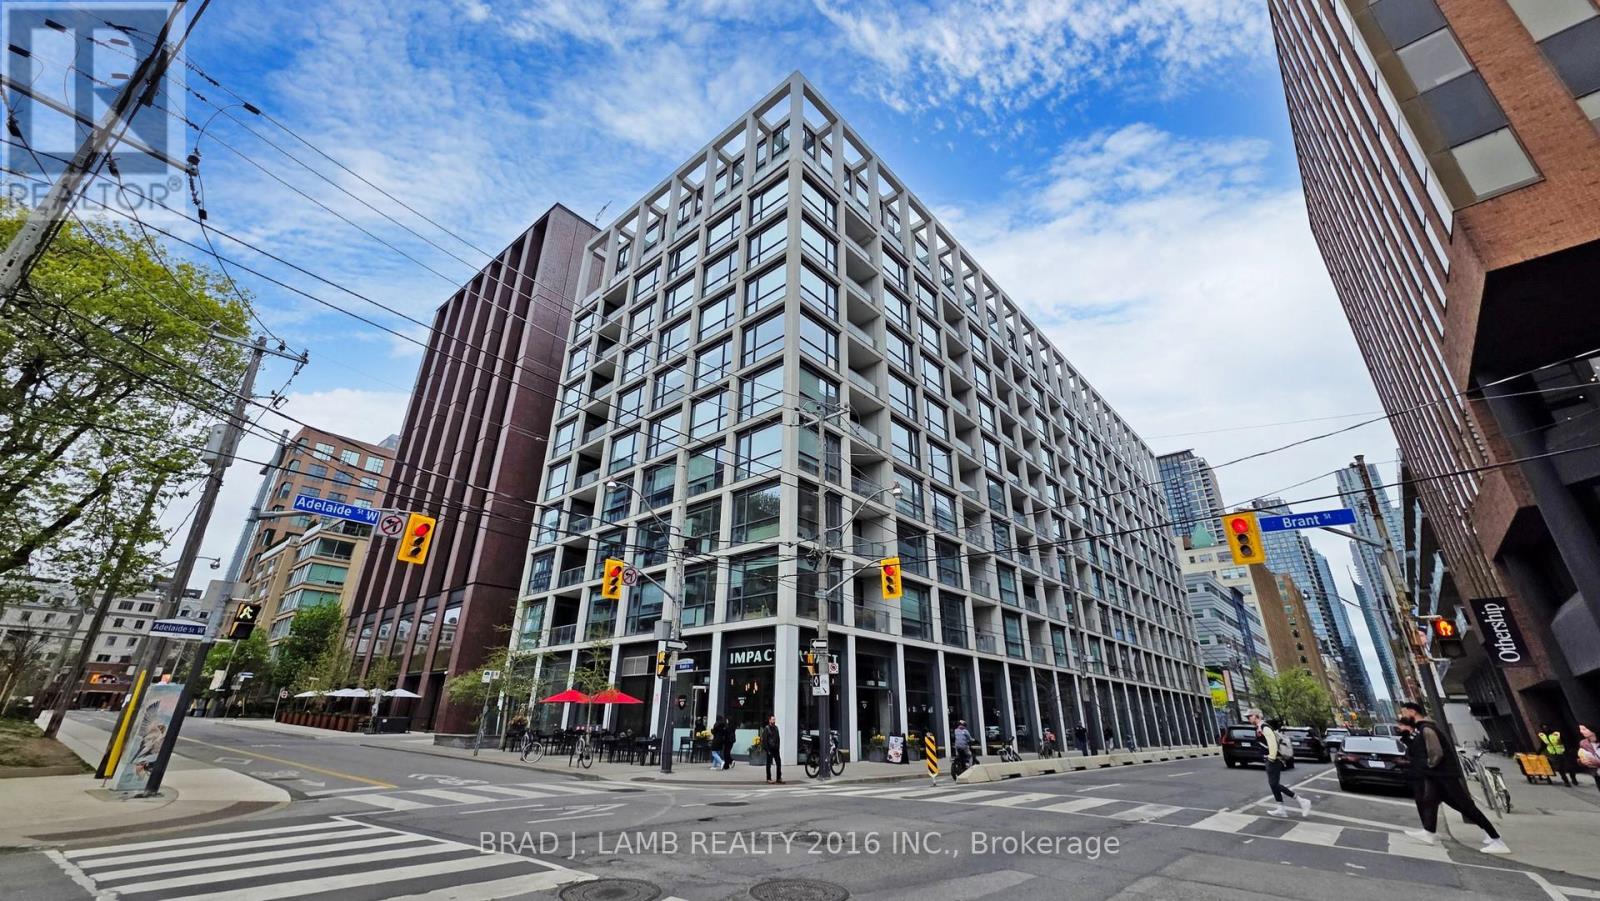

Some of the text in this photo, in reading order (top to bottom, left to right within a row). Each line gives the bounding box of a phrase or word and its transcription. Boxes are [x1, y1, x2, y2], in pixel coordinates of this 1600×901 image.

[296, 496, 352, 516] Adelaide
[366, 512, 378, 521] W
[1282, 512, 1331, 529] Brant St
[153, 623, 188, 633] Adelaide
[1481, 603, 1521, 663] Othership
[730, 649, 776, 664] IMPAC
